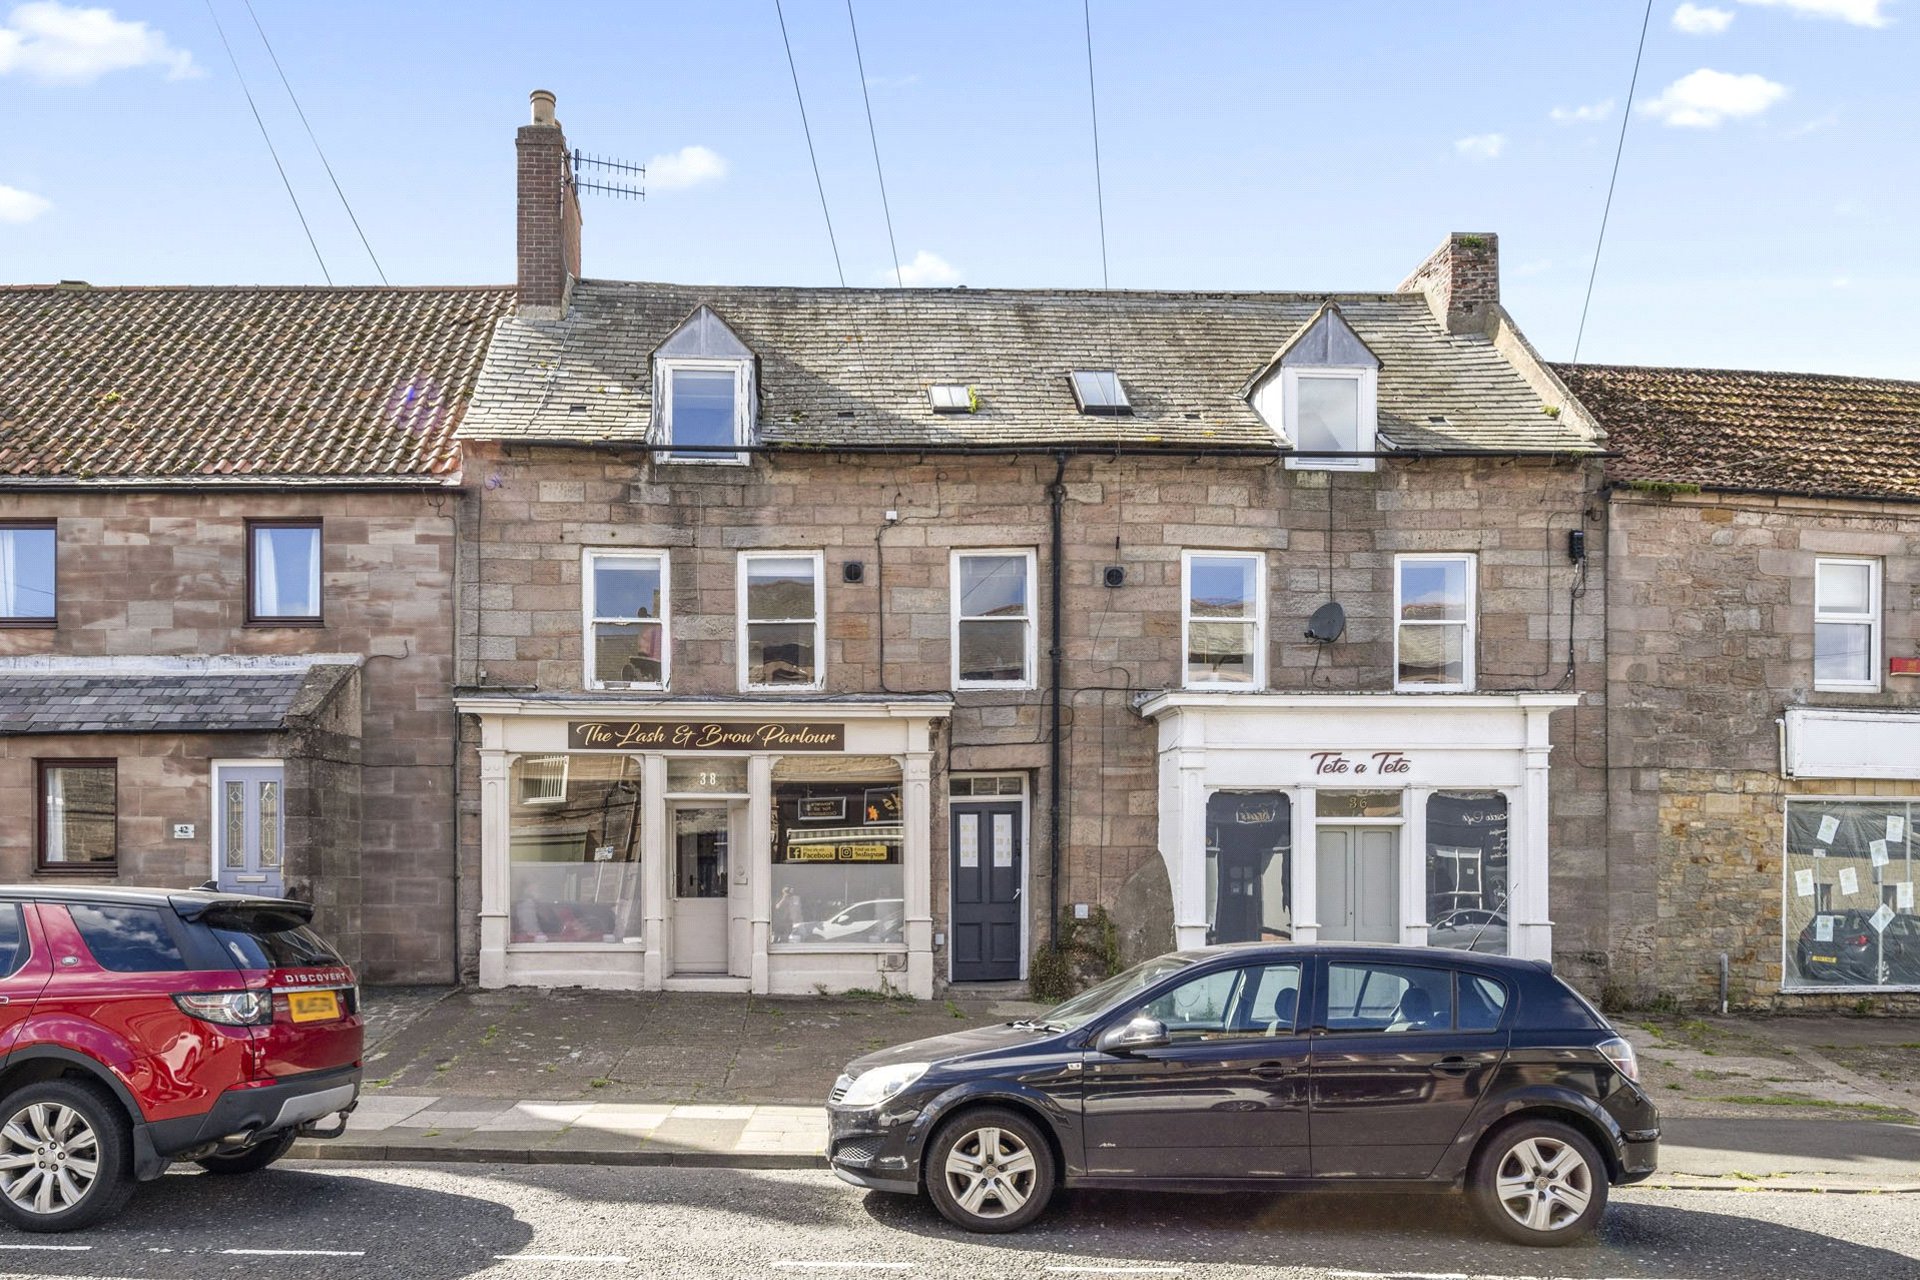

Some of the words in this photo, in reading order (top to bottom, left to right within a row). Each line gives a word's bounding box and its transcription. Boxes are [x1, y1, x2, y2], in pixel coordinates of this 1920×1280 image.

[576, 722, 613, 746] The
[614, 722, 667, 748] Lash
[672, 724, 697, 748] &
[695, 723, 756, 747] Brow
[756, 723, 838, 747] Parlour
[1310, 752, 1350, 775] Tete
[1354, 763, 1368, 774] a
[1372, 752, 1412, 775] Tete
[700, 772, 716, 785] 38
[1348, 796, 1368, 809] 36
[803, 851, 834, 859] Facebook
[285, 972, 346, 983] DISCOVERY
